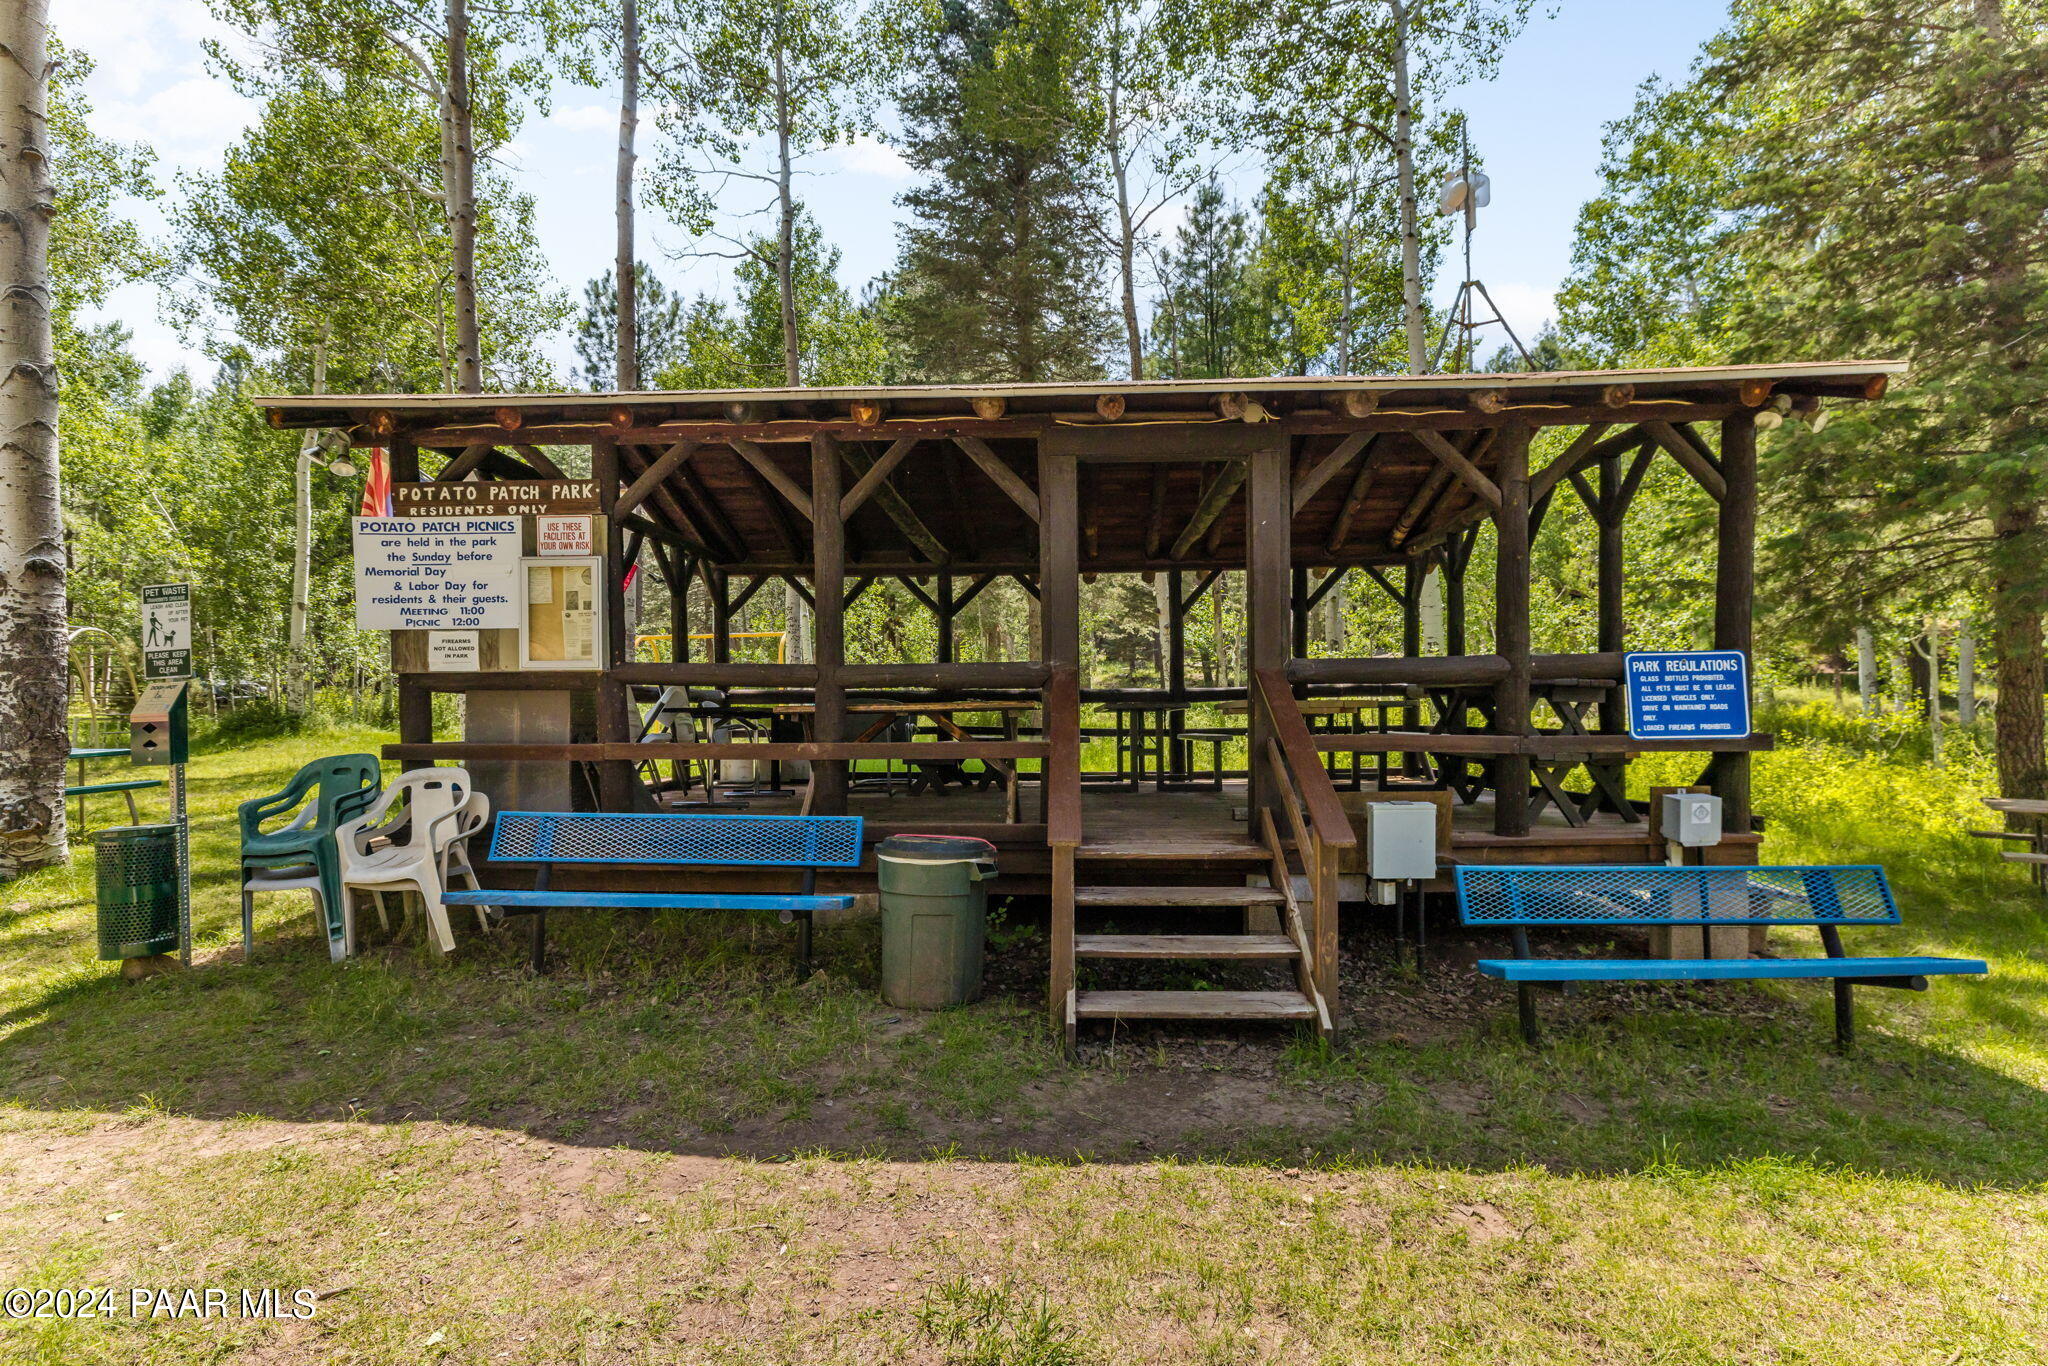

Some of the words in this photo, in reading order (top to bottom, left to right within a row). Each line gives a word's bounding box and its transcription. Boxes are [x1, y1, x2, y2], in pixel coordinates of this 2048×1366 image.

[399, 486, 477, 501] POTATO
[489, 485, 540, 500] PATCH
[552, 483, 594, 500] PARK
[410, 505, 494, 516] RESIDENTS
[507, 504, 547, 515] ONLY
[360, 522, 416, 532] POTATO
[422, 522, 460, 532] PATCH
[466, 521, 515, 532] PICNICS
[547, 522, 560, 531] USE
[562, 522, 582, 531] THESE
[543, 532, 576, 541] FACILITIES
[578, 532, 586, 540] AT
[407, 537, 430, 547] held
[435, 537, 444, 546] in
[450, 537, 467, 547] the
[472, 537, 497, 549] park
[540, 541, 557, 550] YOUR
[558, 541, 573, 550] OWN
[575, 541, 590, 550] RISK
[387, 553, 406, 562] the
[412, 552, 451, 563] Sunday
[457, 552, 493, 562] before
[365, 567, 420, 577] Memorial
[424, 567, 447, 578] Day
[145, 588, 159, 597] PET
[161, 586, 187, 596] WASTE
[393, 582, 402, 591] &
[409, 582, 440, 591] Labor
[445, 581, 467, 592] Day
[472, 581, 489, 590] for
[372, 596, 423, 604] residents
[428, 595, 437, 604] &
[443, 595, 467, 604] their
[472, 594, 509, 606] guests.
[400, 607, 448, 616] MEETING
[460, 606, 485, 615] 11:00
[406, 618, 441, 627] PICNIC
[452, 617, 480, 626] 12:00
[1632, 660, 1661, 673] PARK
[1665, 659, 1739, 672] REGULATIONS
[1640, 675, 1659, 683] GLASS
